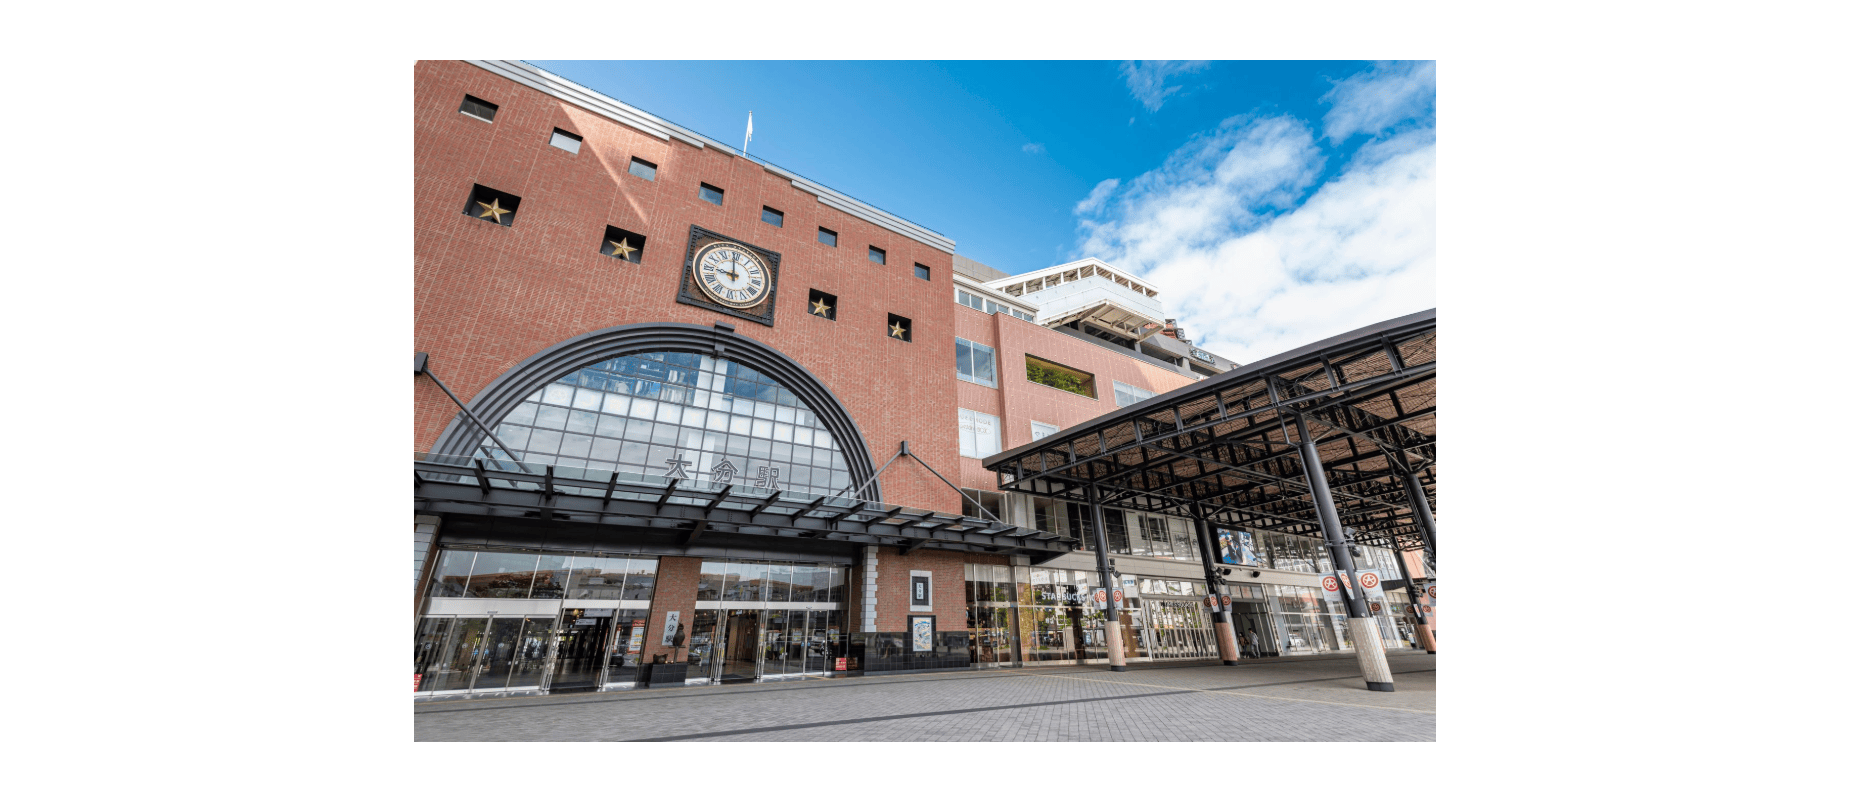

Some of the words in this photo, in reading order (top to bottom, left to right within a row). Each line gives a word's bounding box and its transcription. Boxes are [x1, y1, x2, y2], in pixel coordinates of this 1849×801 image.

[662, 453, 781, 490] 大分駅
[1041, 592, 1086, 602] STARBUCKS
[664, 613, 677, 643] 大分駅
